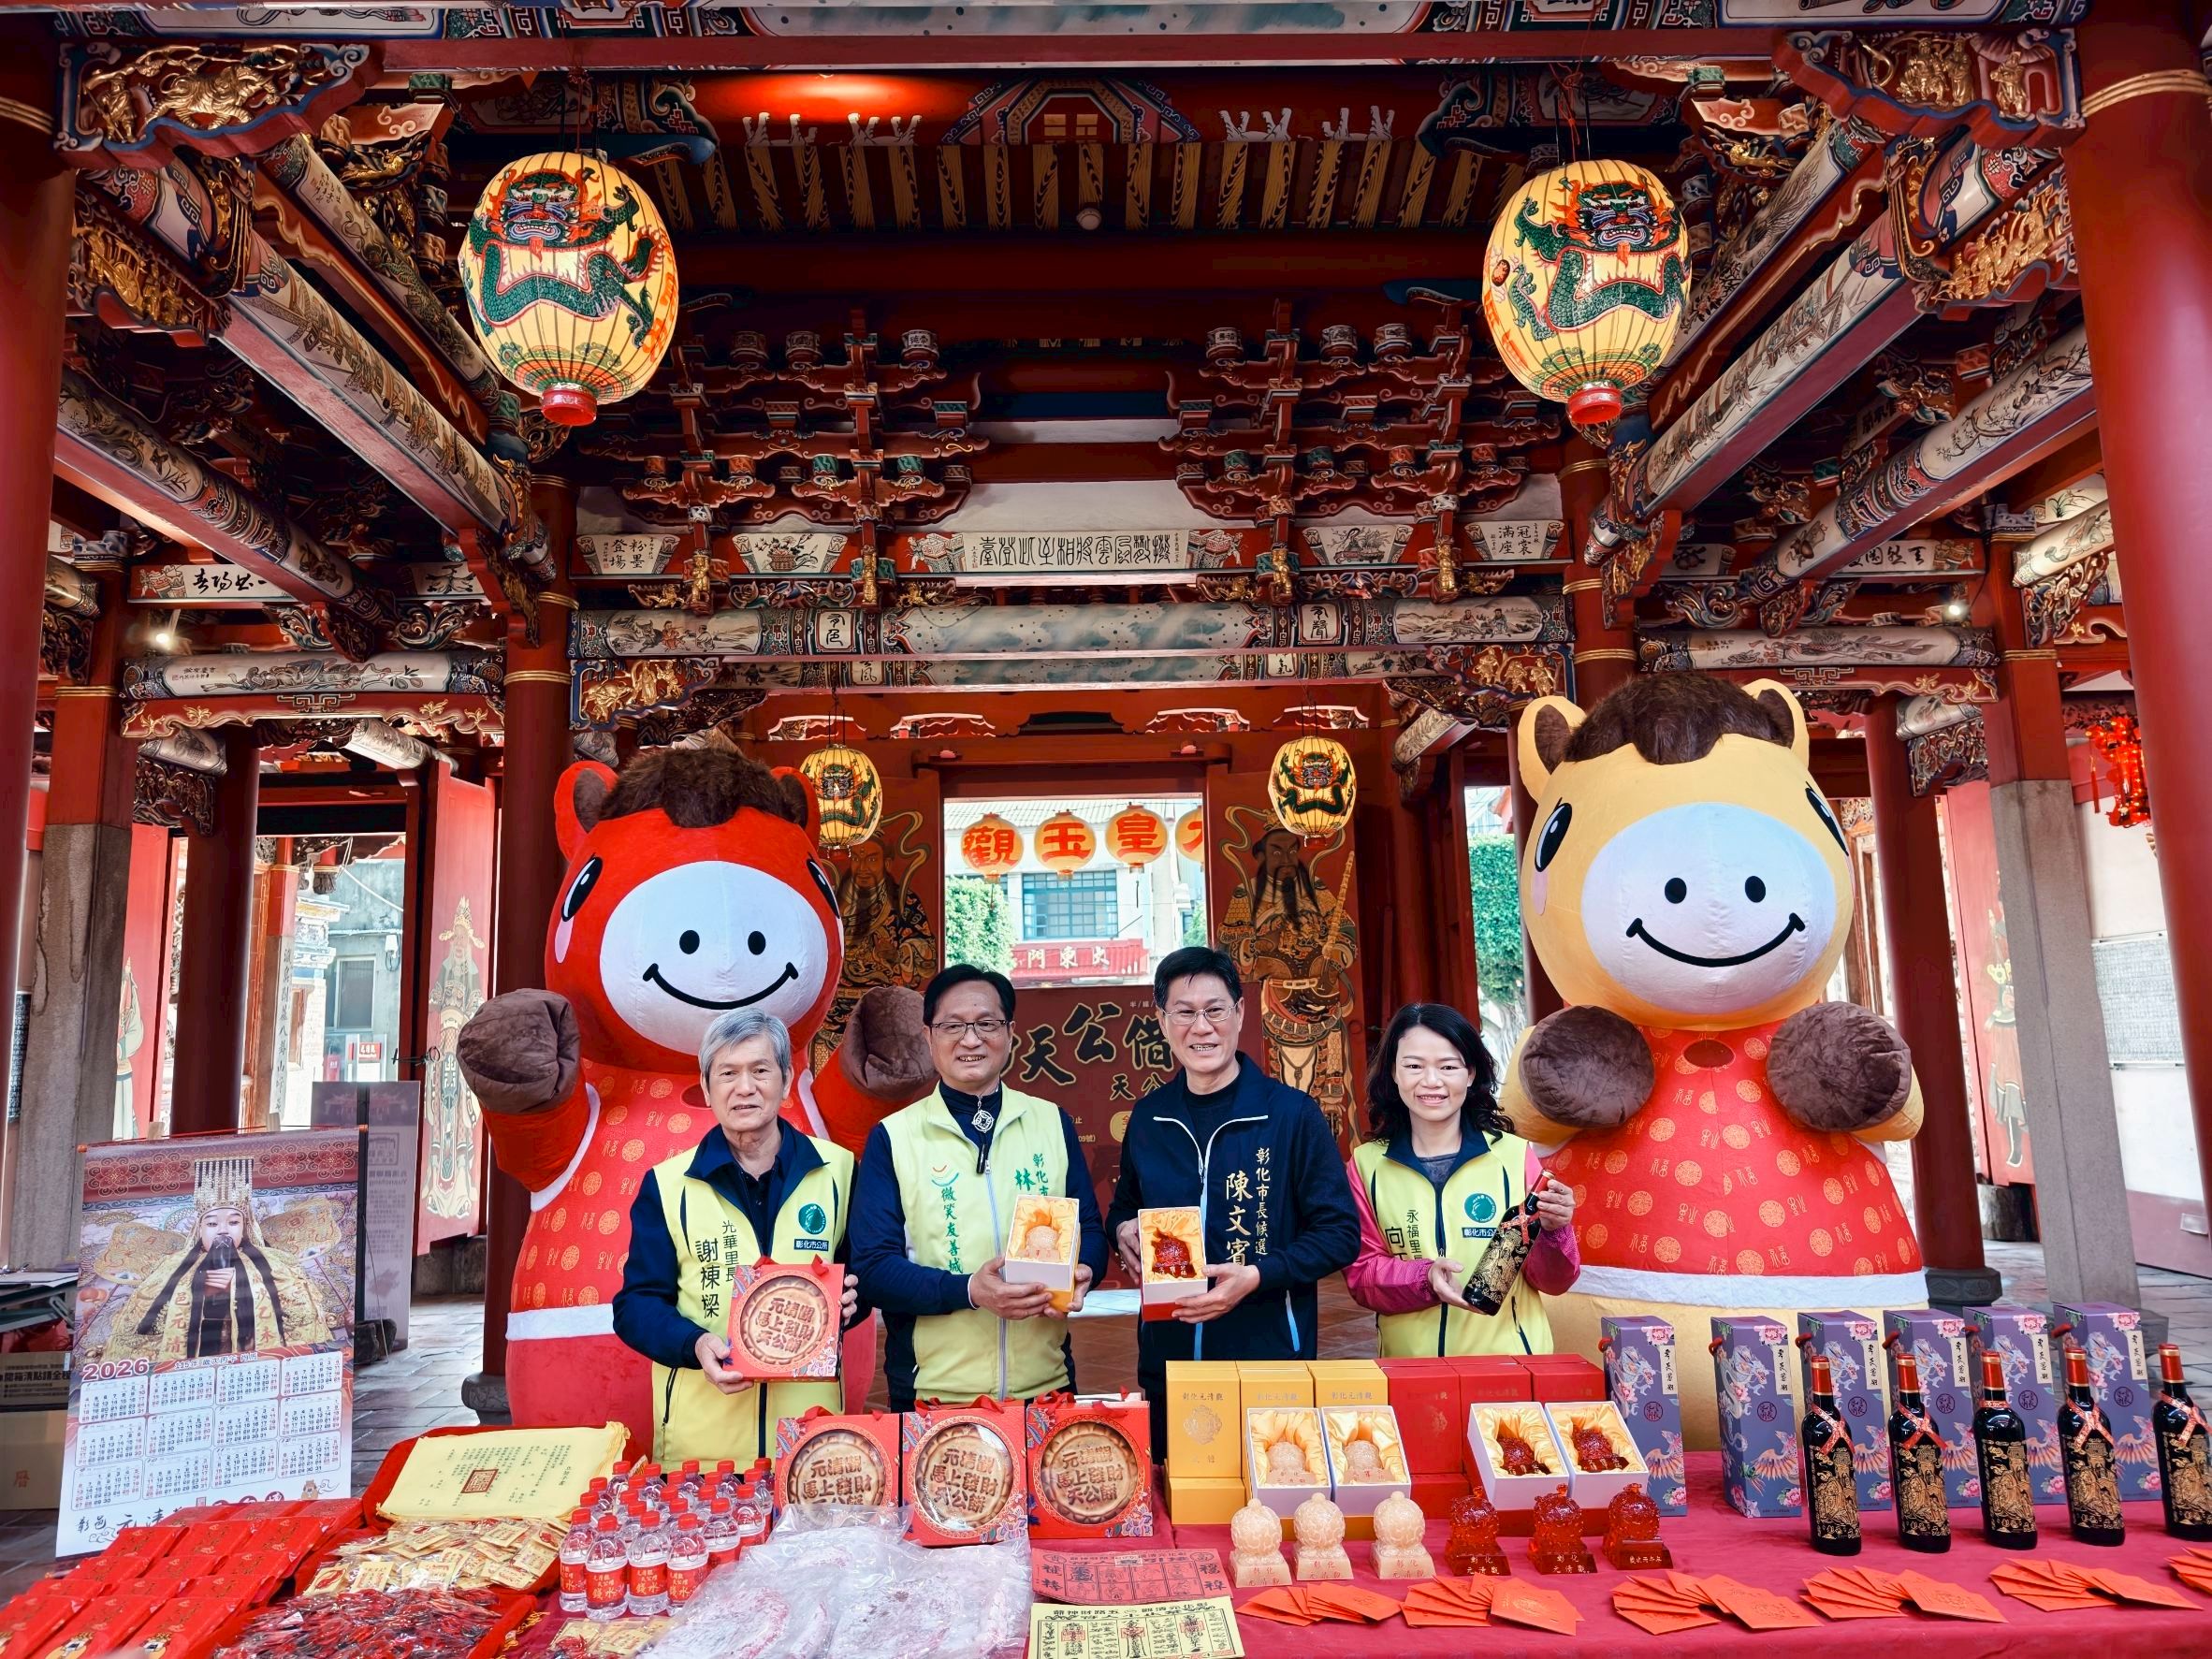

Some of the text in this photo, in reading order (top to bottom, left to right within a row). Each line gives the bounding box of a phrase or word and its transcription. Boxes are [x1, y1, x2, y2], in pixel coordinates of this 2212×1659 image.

[629, 538, 648, 569] 粉墨
[1498, 525, 1515, 555] 滿座
[1517, 525, 1533, 555] 冠裳
[964, 825, 1017, 866] 觀
[1041, 822, 1092, 860] 玉
[1116, 813, 1163, 858] 皇
[1014, 1168, 1037, 1191] 林
[1032, 1153, 1049, 1197] 彰化市
[1255, 1147, 1271, 1261] 彰化市長候選
[795, 1240, 829, 1250] 彰化市公所
[941, 1186, 964, 1274] 微笑友善城
[721, 1220, 739, 1282] 光華里長
[768, 1297, 816, 1323] 元清觀
[755, 1310, 815, 1341] 馬上發財
[82, 1359, 150, 1381] 2026
[1183, 1392, 1224, 1401] 彰化元清觀
[1332, 1391, 1373, 1401] 彰化元清觀
[810, 1455, 862, 1478] 元清觀
[943, 1448, 996, 1474] 元清觀
[1062, 1445, 1113, 1466] 元清觀
[803, 1475, 872, 1499] 馬上發財
[930, 1464, 998, 1496] 馬上發財
[1057, 1463, 1123, 1490] 馬上發財
